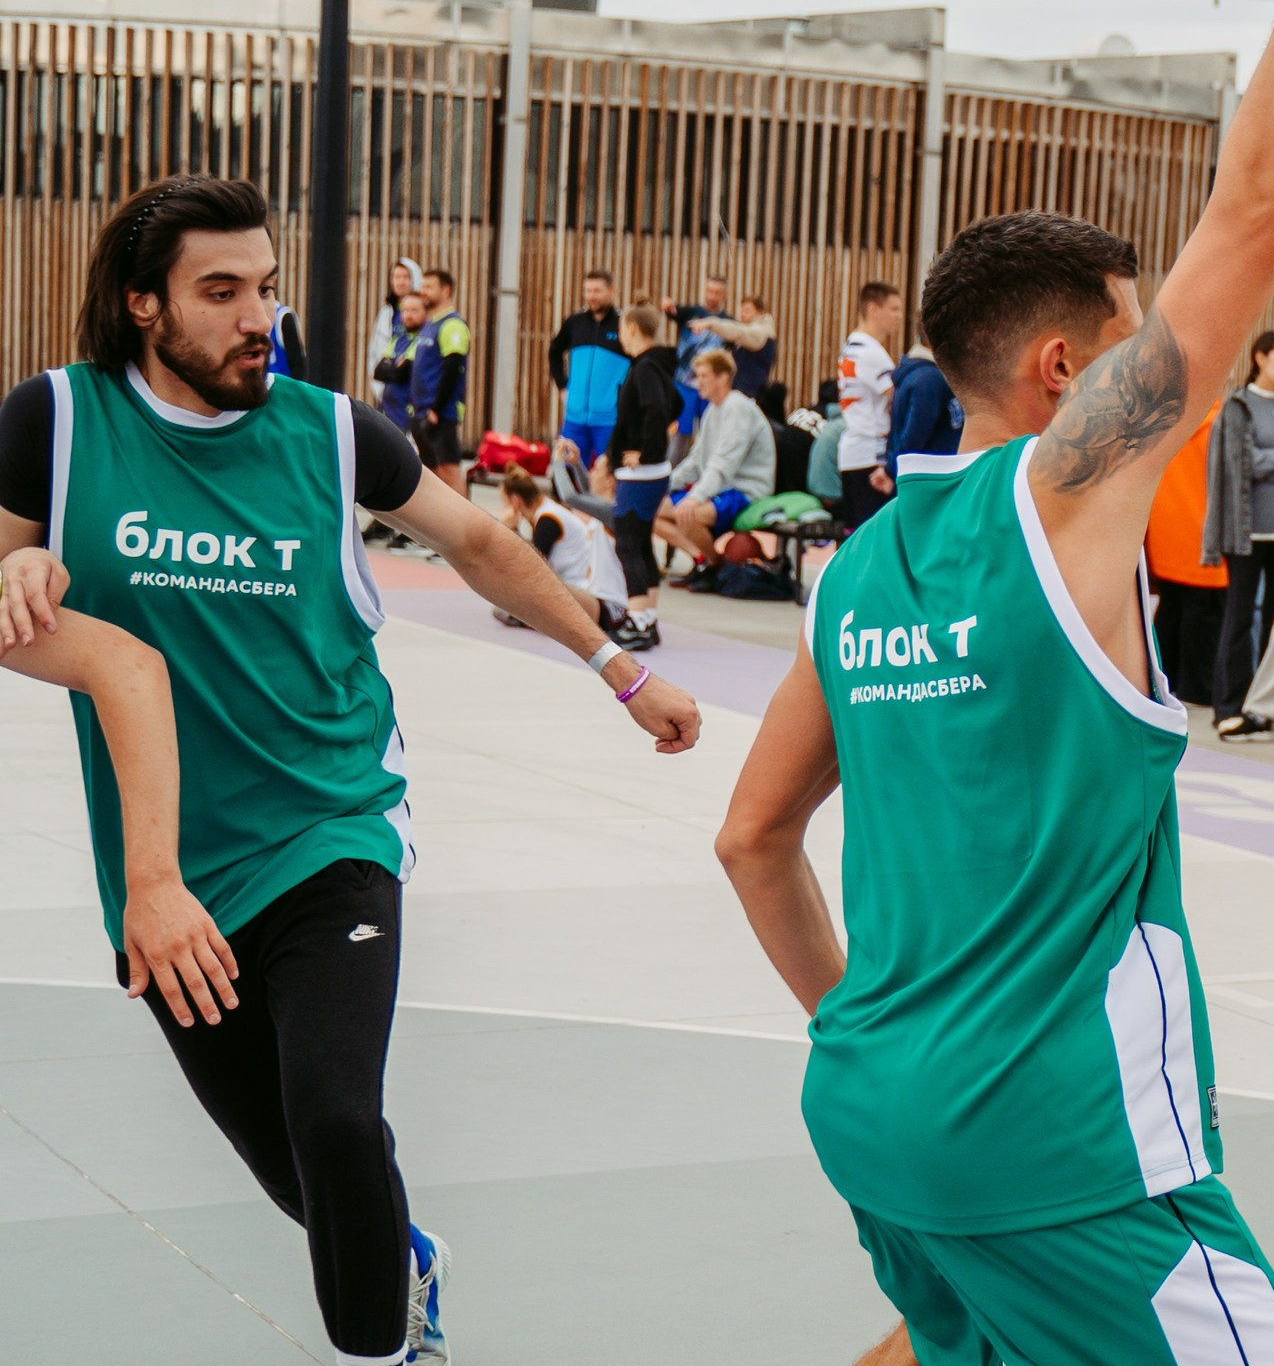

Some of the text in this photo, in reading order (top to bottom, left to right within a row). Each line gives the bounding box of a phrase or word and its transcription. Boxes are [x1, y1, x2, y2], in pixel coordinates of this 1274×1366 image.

[115, 510, 301, 571] блок т
[129, 571, 297, 596] #КОМАНДАСБЕРА
[839, 609, 977, 671] блок т
[850, 673, 987, 705] #КОМАНДАСБЕРА
